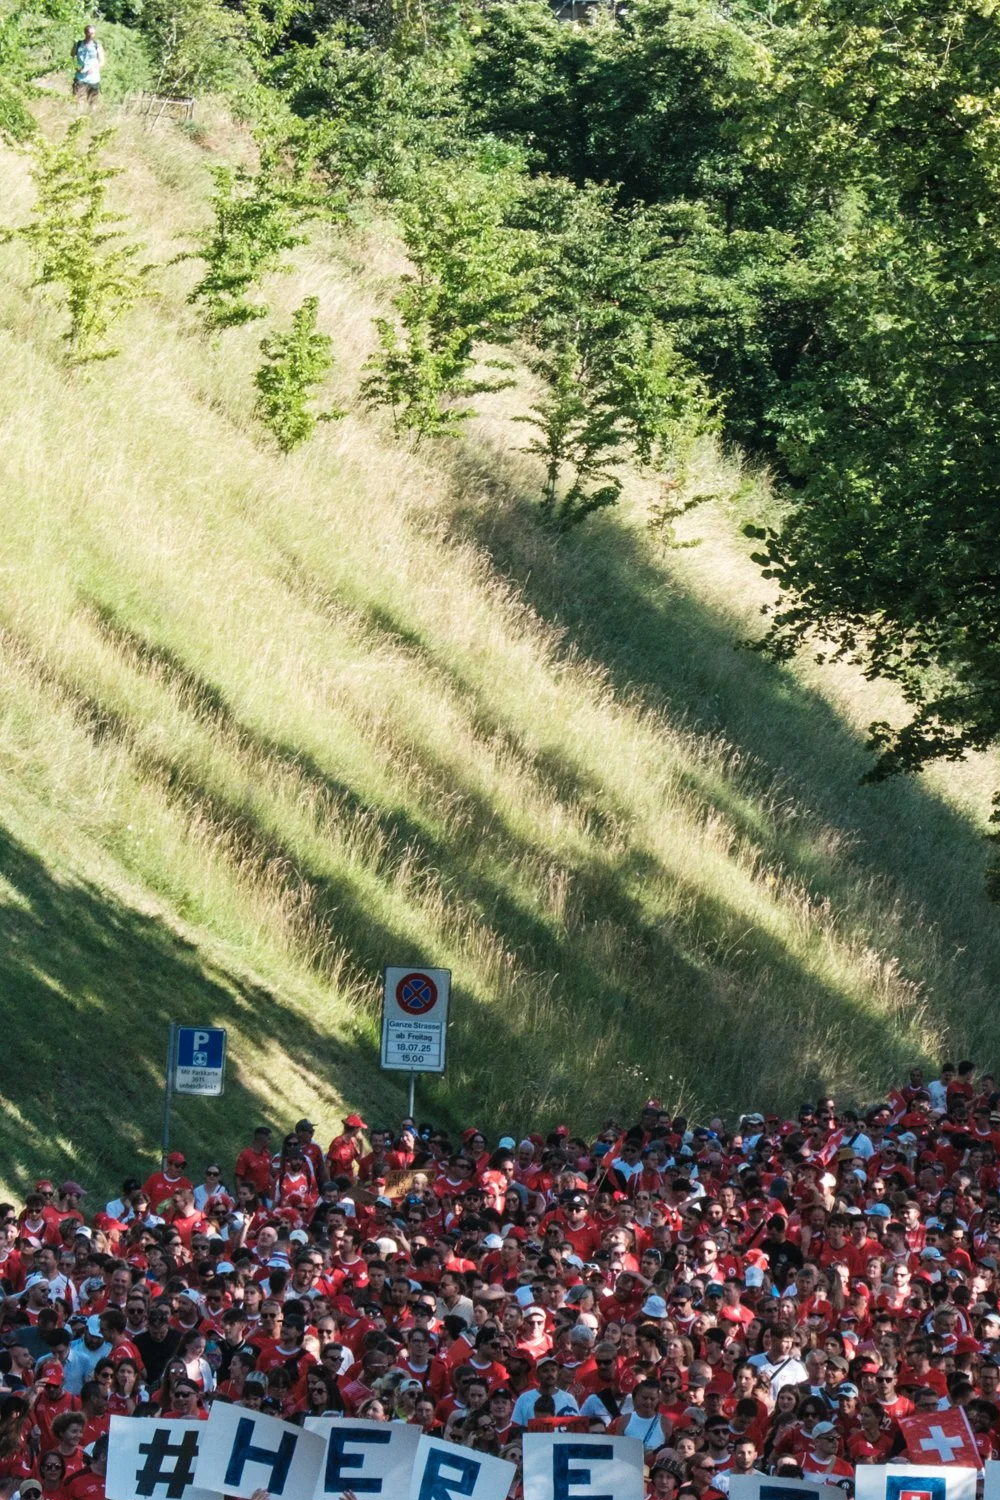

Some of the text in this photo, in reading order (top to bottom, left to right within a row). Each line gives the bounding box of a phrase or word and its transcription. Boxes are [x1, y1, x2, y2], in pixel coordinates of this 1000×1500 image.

[389, 1021, 441, 1031] Ganze Strasse
[193, 1031, 209, 1051] P
[395, 1033, 433, 1043] ab Freitag
[397, 1043, 431, 1053] 18.07.25
[402, 1054, 424, 1063] 15.00
